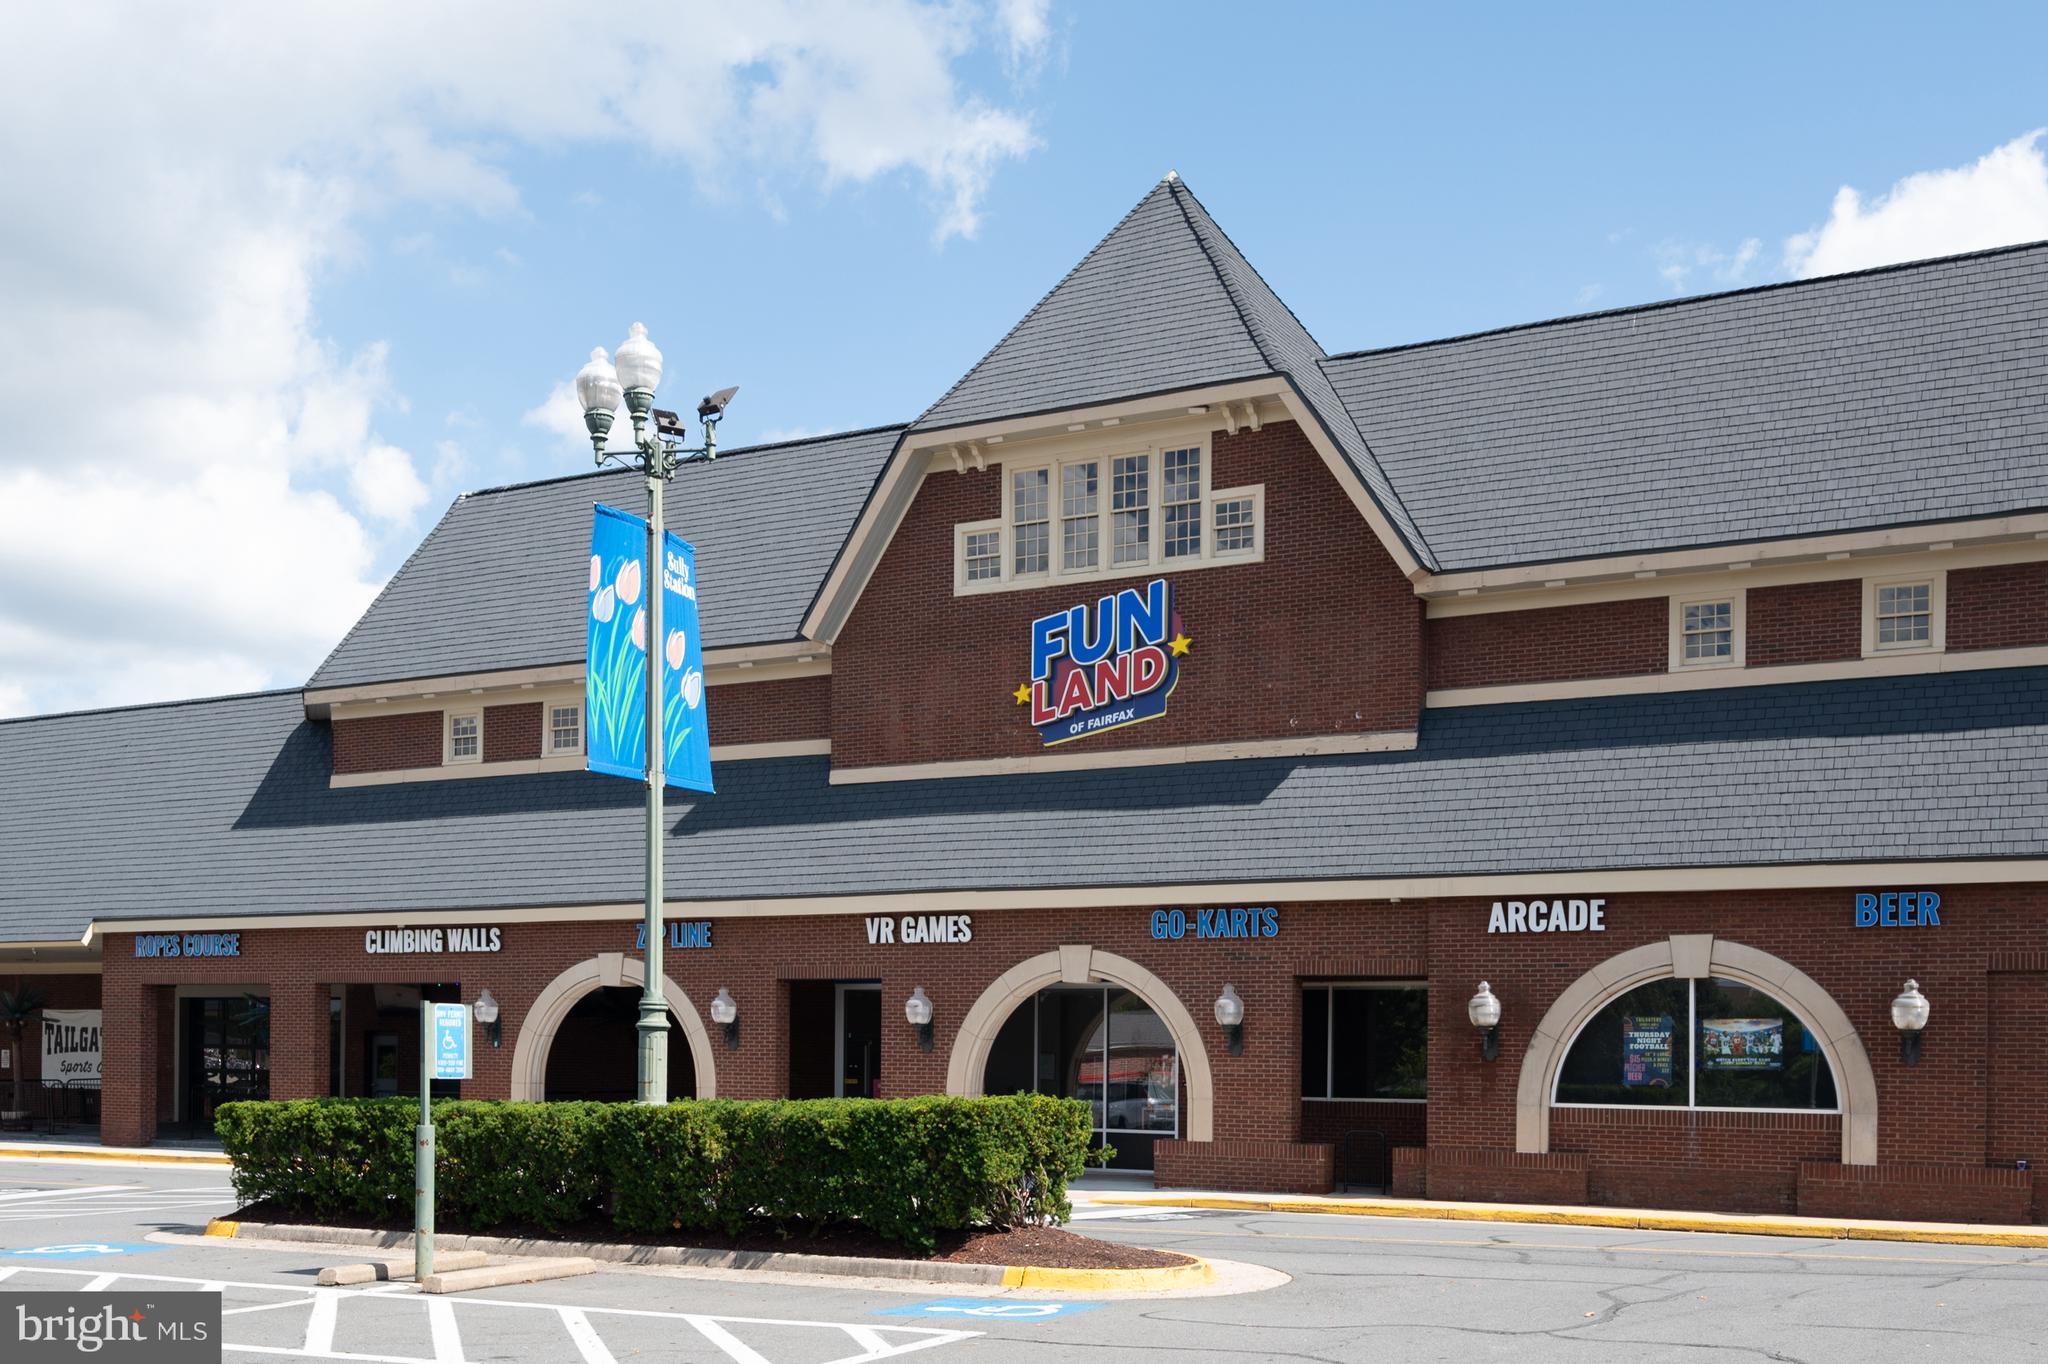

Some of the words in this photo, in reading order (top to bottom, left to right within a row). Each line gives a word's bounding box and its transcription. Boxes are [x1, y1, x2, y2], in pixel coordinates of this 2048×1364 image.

[667, 551, 690, 583] Sully
[663, 569, 696, 601] Station
[1031, 578, 1168, 681] FUN
[1031, 646, 1168, 727] LAND
[1070, 721, 1085, 735] OF
[1088, 708, 1135, 730] FAIRFAX
[1150, 907, 1279, 940] GO-KARTS
[1487, 899, 1606, 933] ARCADE
[1855, 891, 1941, 928] BEER
[135, 935, 181, 957] ROPES
[183, 933, 241, 957] COURSE
[365, 929, 443, 954] CLIMBING
[446, 927, 502, 953] WALLS
[671, 922, 713, 949] LINE
[864, 916, 895, 945] VR
[901, 914, 973, 944] GAMES
[60, 1060, 93, 1076] Sports
